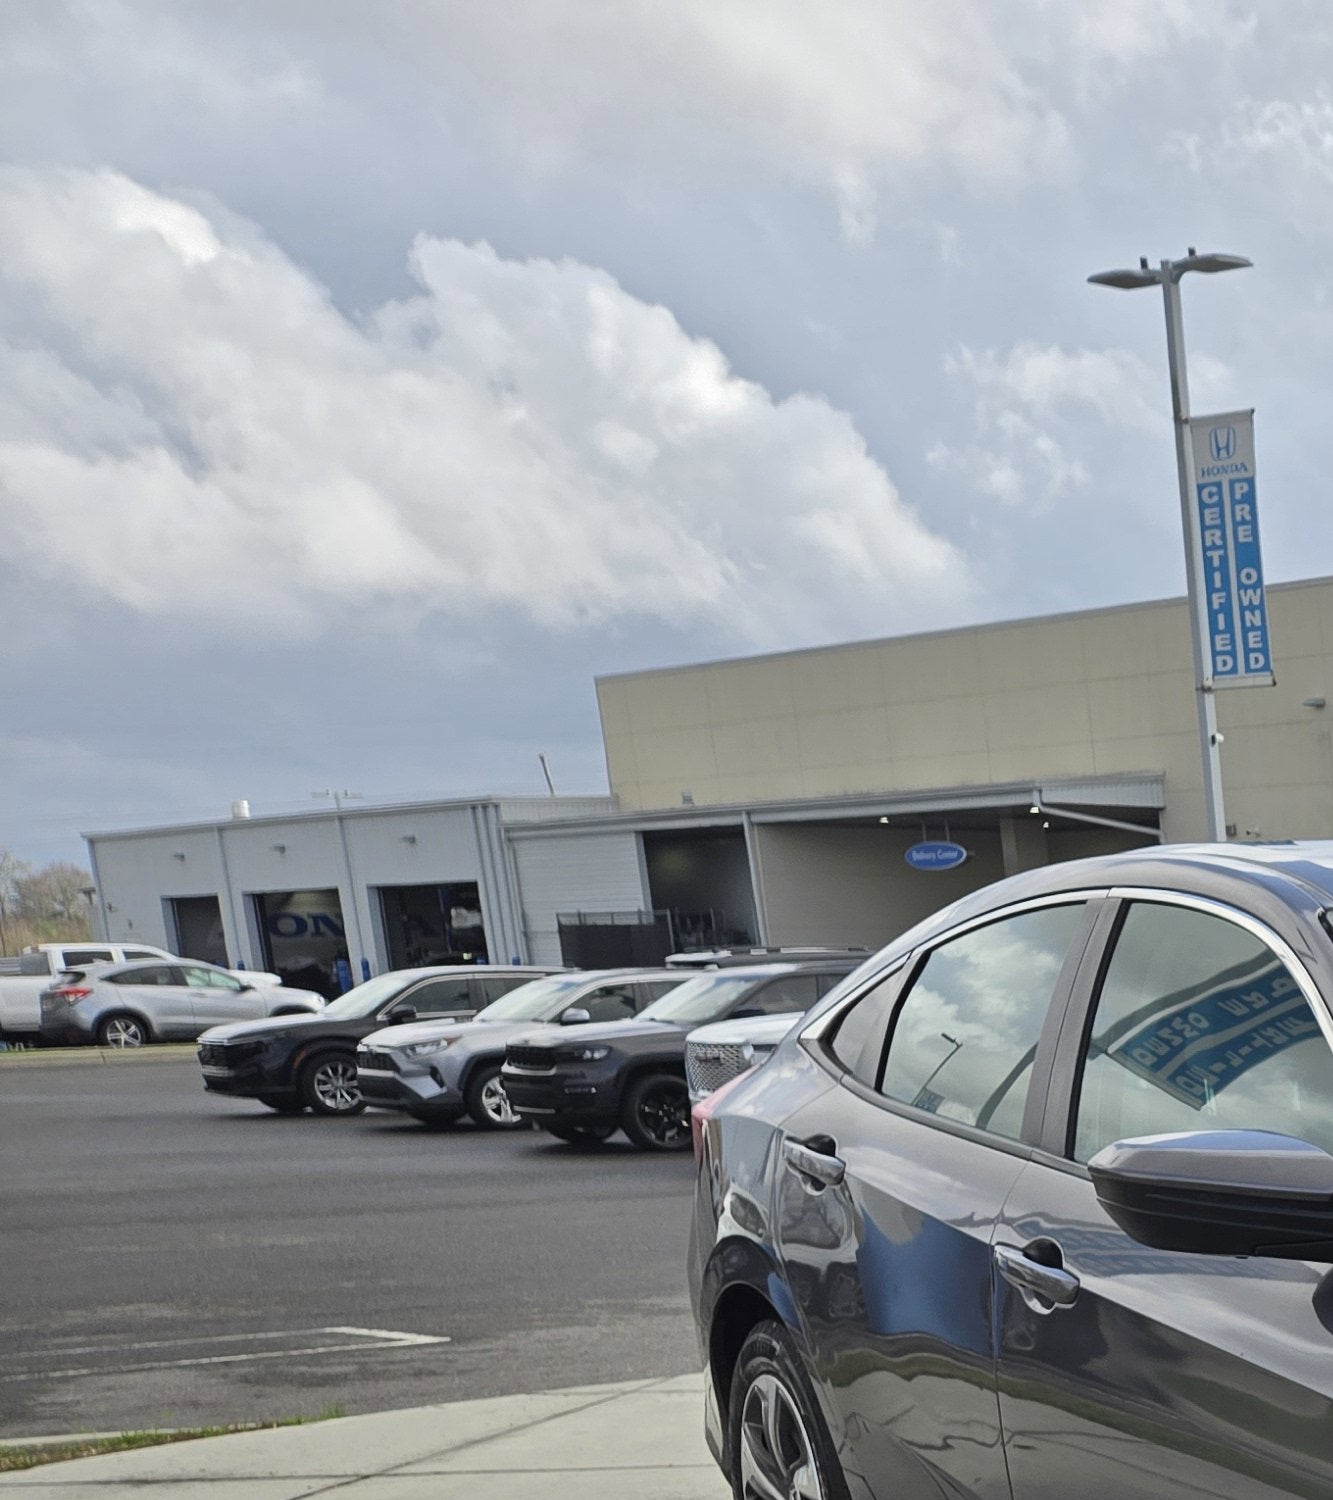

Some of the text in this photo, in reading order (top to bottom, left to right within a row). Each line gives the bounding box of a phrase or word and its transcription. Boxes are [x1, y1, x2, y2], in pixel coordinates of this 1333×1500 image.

[1201, 462, 1248, 478] HONDA
[1201, 486, 1234, 673] CERTIFIED
[1234, 482, 1266, 670] PRE OWNED
